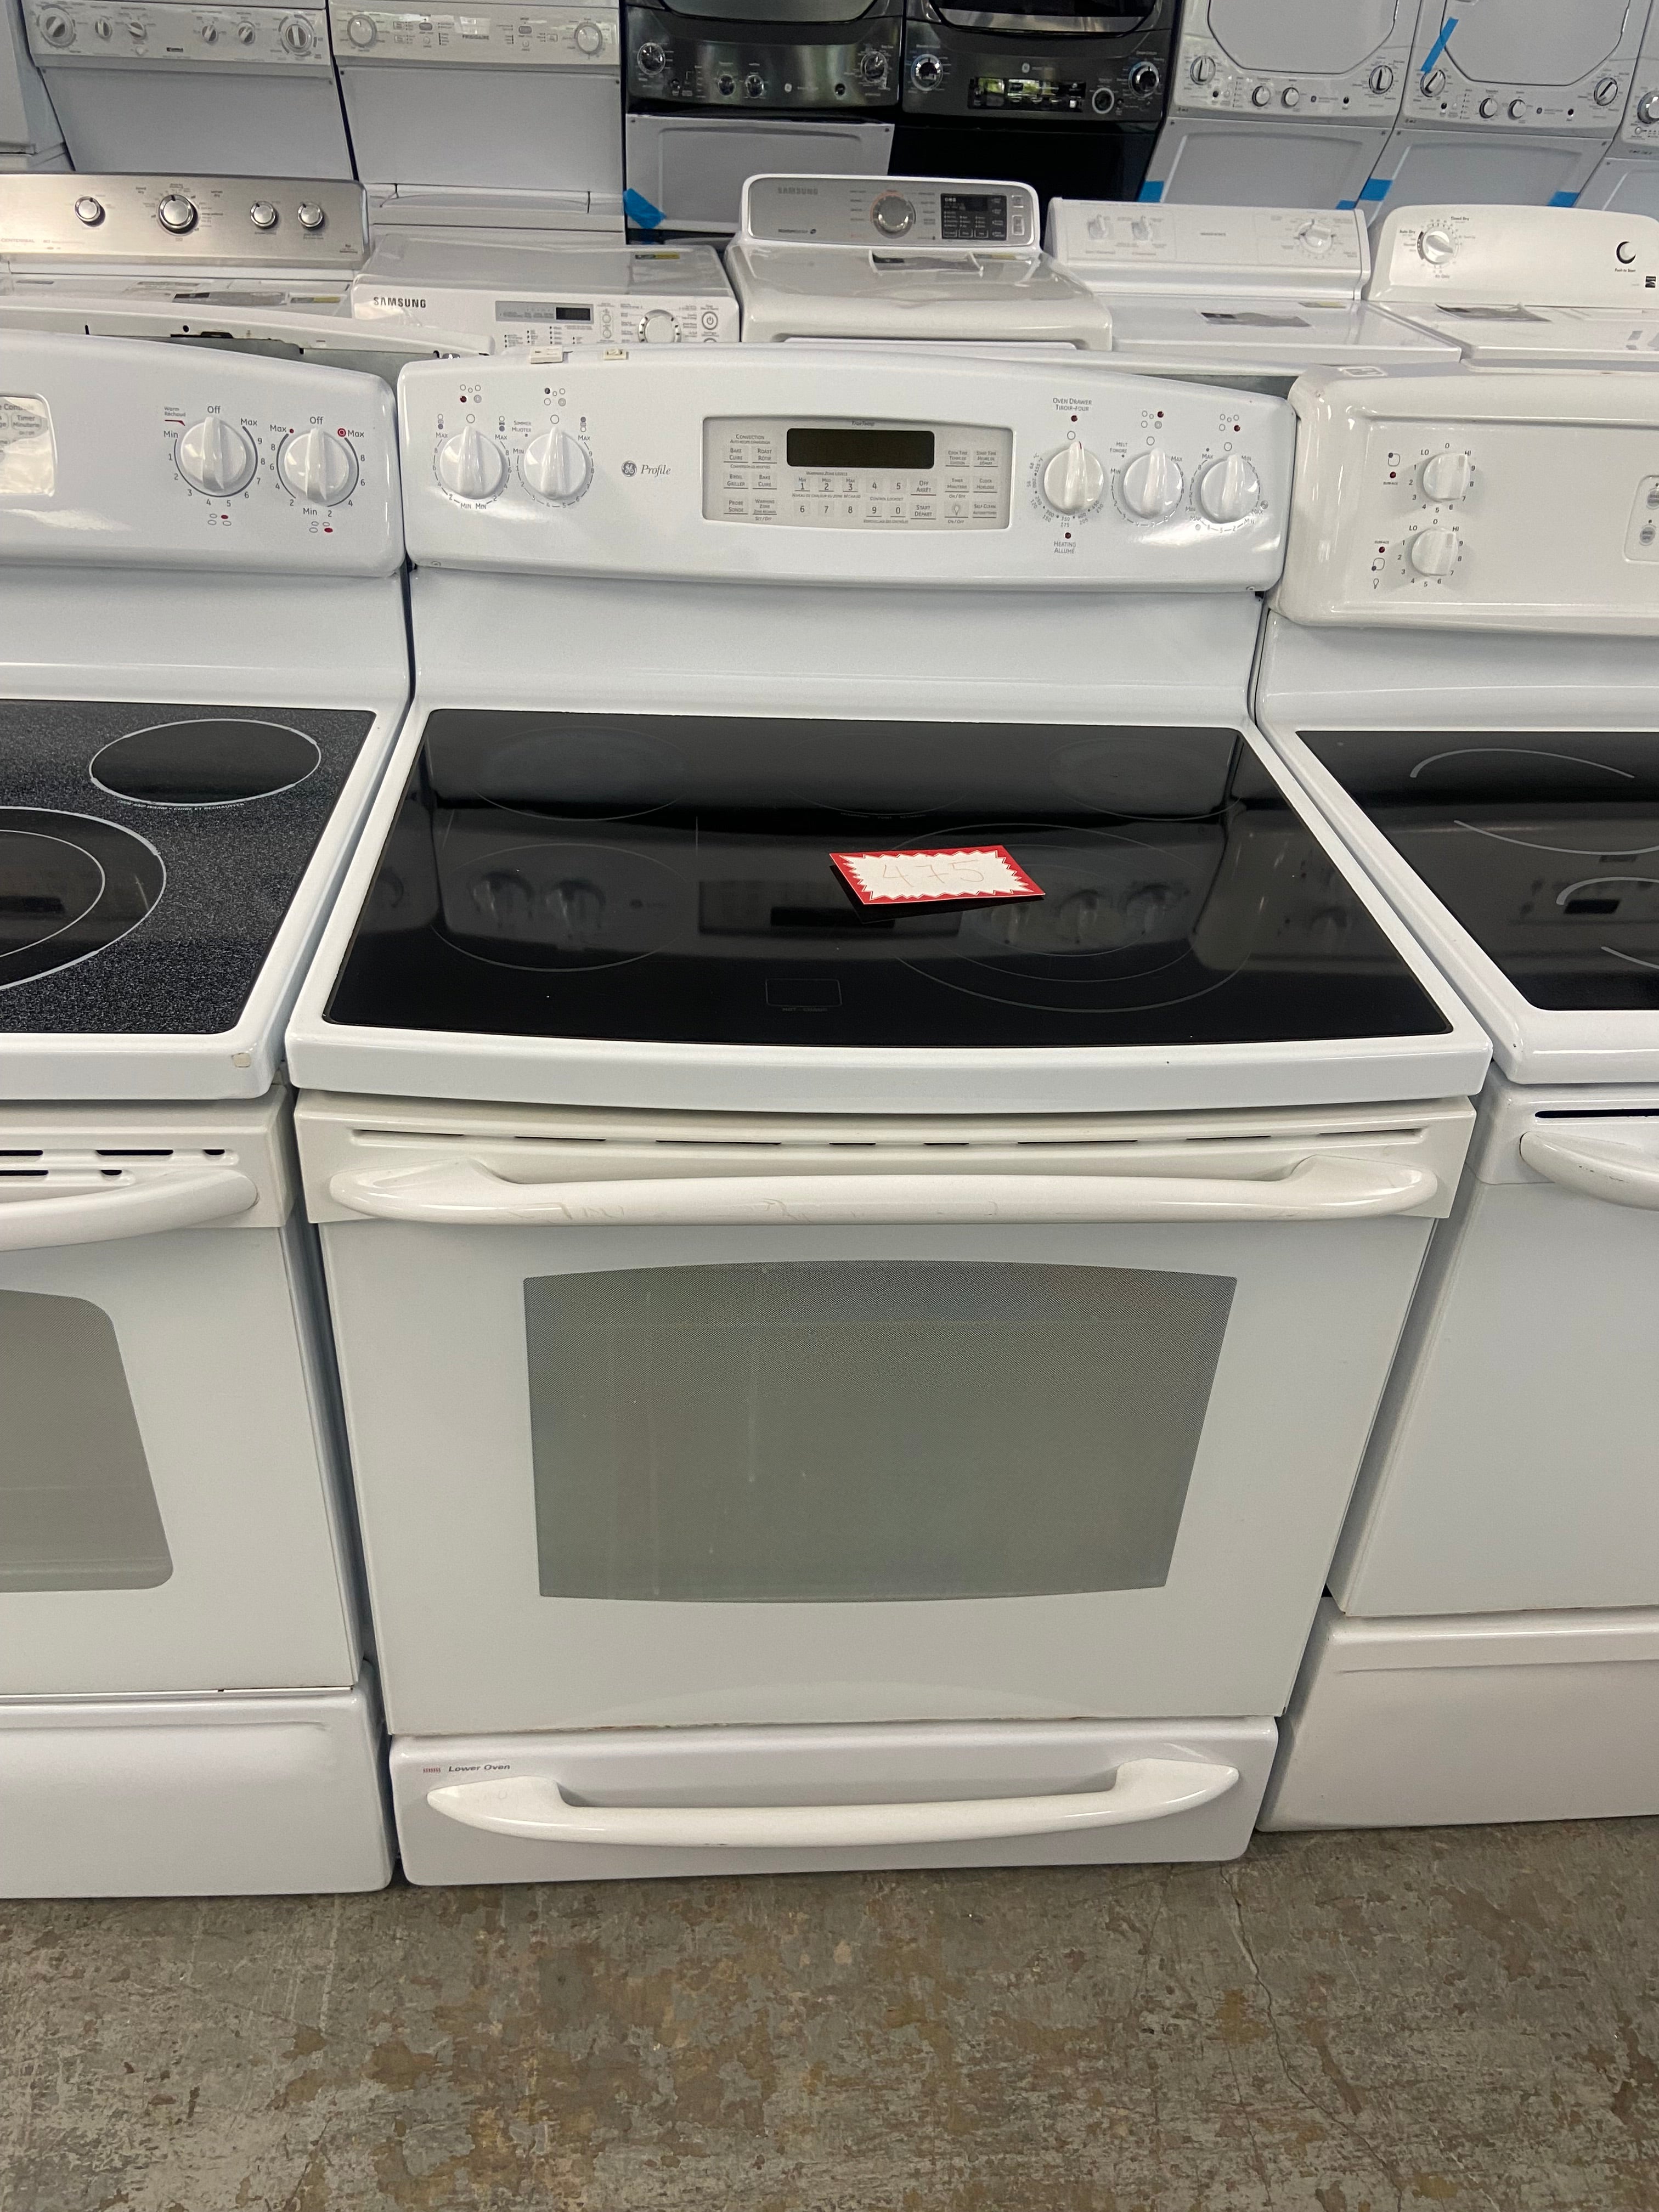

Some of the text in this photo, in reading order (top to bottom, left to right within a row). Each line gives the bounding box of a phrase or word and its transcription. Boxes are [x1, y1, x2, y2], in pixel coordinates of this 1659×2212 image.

[777, 187, 818, 195] SAMSUNG
[373, 296, 426, 308] SAMSUNG
[207, 405, 221, 414] Off
[309, 416, 323, 425] Off
[641, 464, 672, 478] Profile
[882, 859, 985, 888] 475
